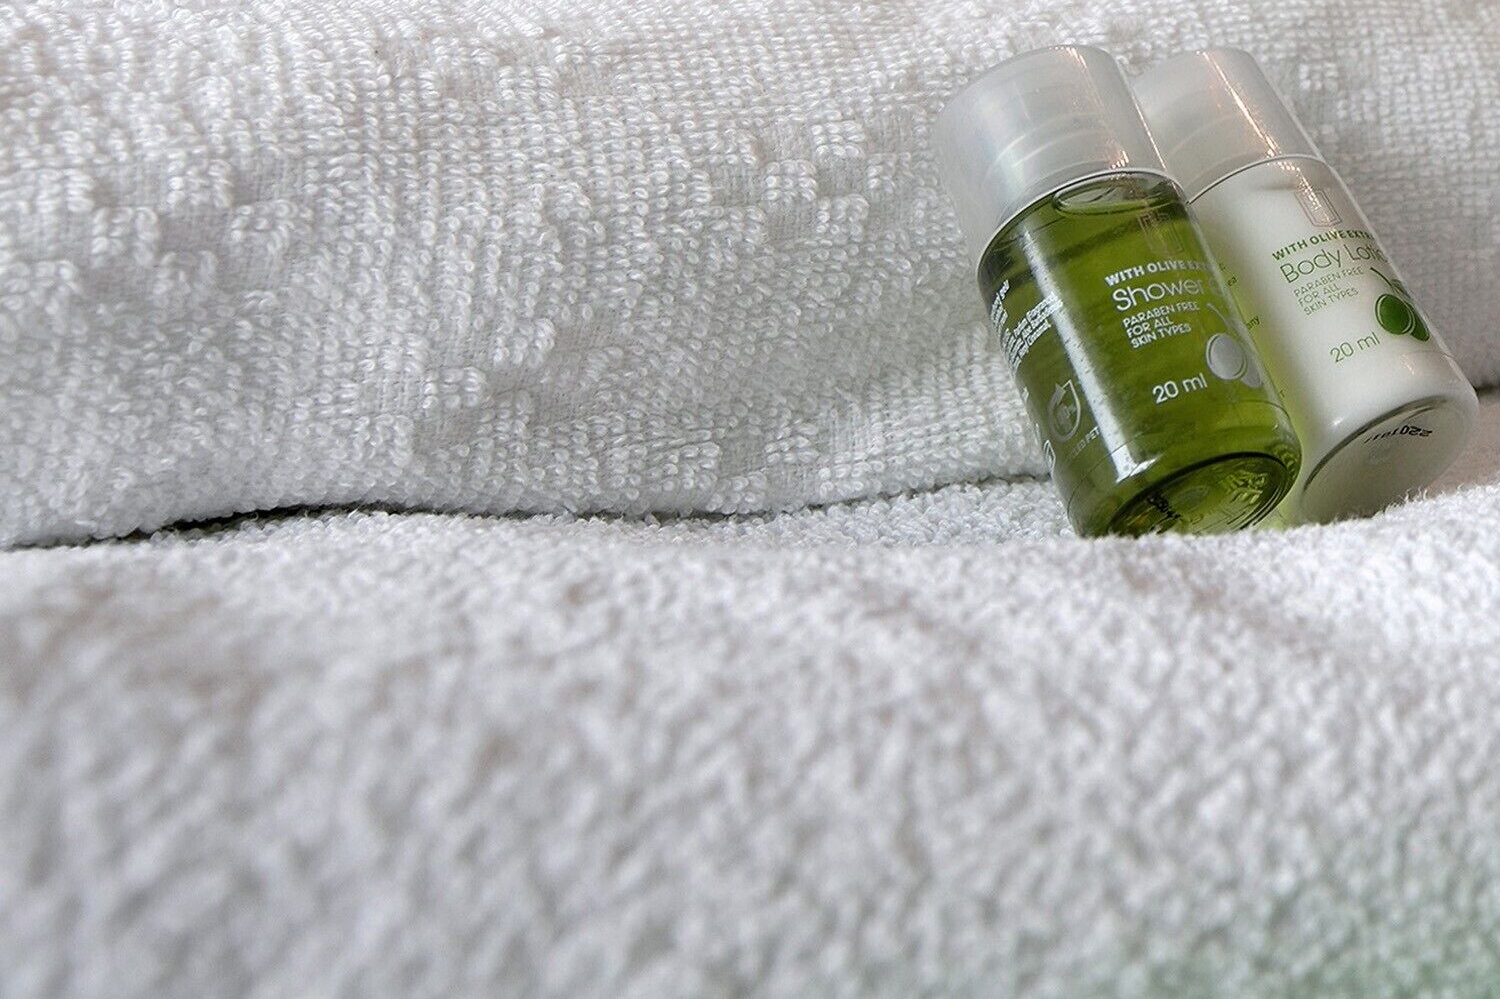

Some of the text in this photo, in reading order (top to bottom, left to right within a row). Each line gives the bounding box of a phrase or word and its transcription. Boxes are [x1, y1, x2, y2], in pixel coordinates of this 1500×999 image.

[1272, 239, 1308, 261] WITH
[1309, 230, 1347, 245] OLIVE
[1104, 265, 1145, 287] WITH
[1147, 260, 1186, 274] OLIVE
[1280, 249, 1341, 283] Body
[1112, 278, 1205, 311] Shower
[1294, 266, 1365, 297] PARABEN FREE
[1298, 282, 1342, 308] FOR ALL
[1122, 301, 1200, 328] PARABEN FREE
[1304, 287, 1359, 316] SKIN TYPES
[1126, 316, 1175, 338] FOR ALL
[1131, 323, 1192, 349] SKIN TYPES
[1330, 331, 1381, 363] 20 ml
[1152, 372, 1208, 404] 20 ml
